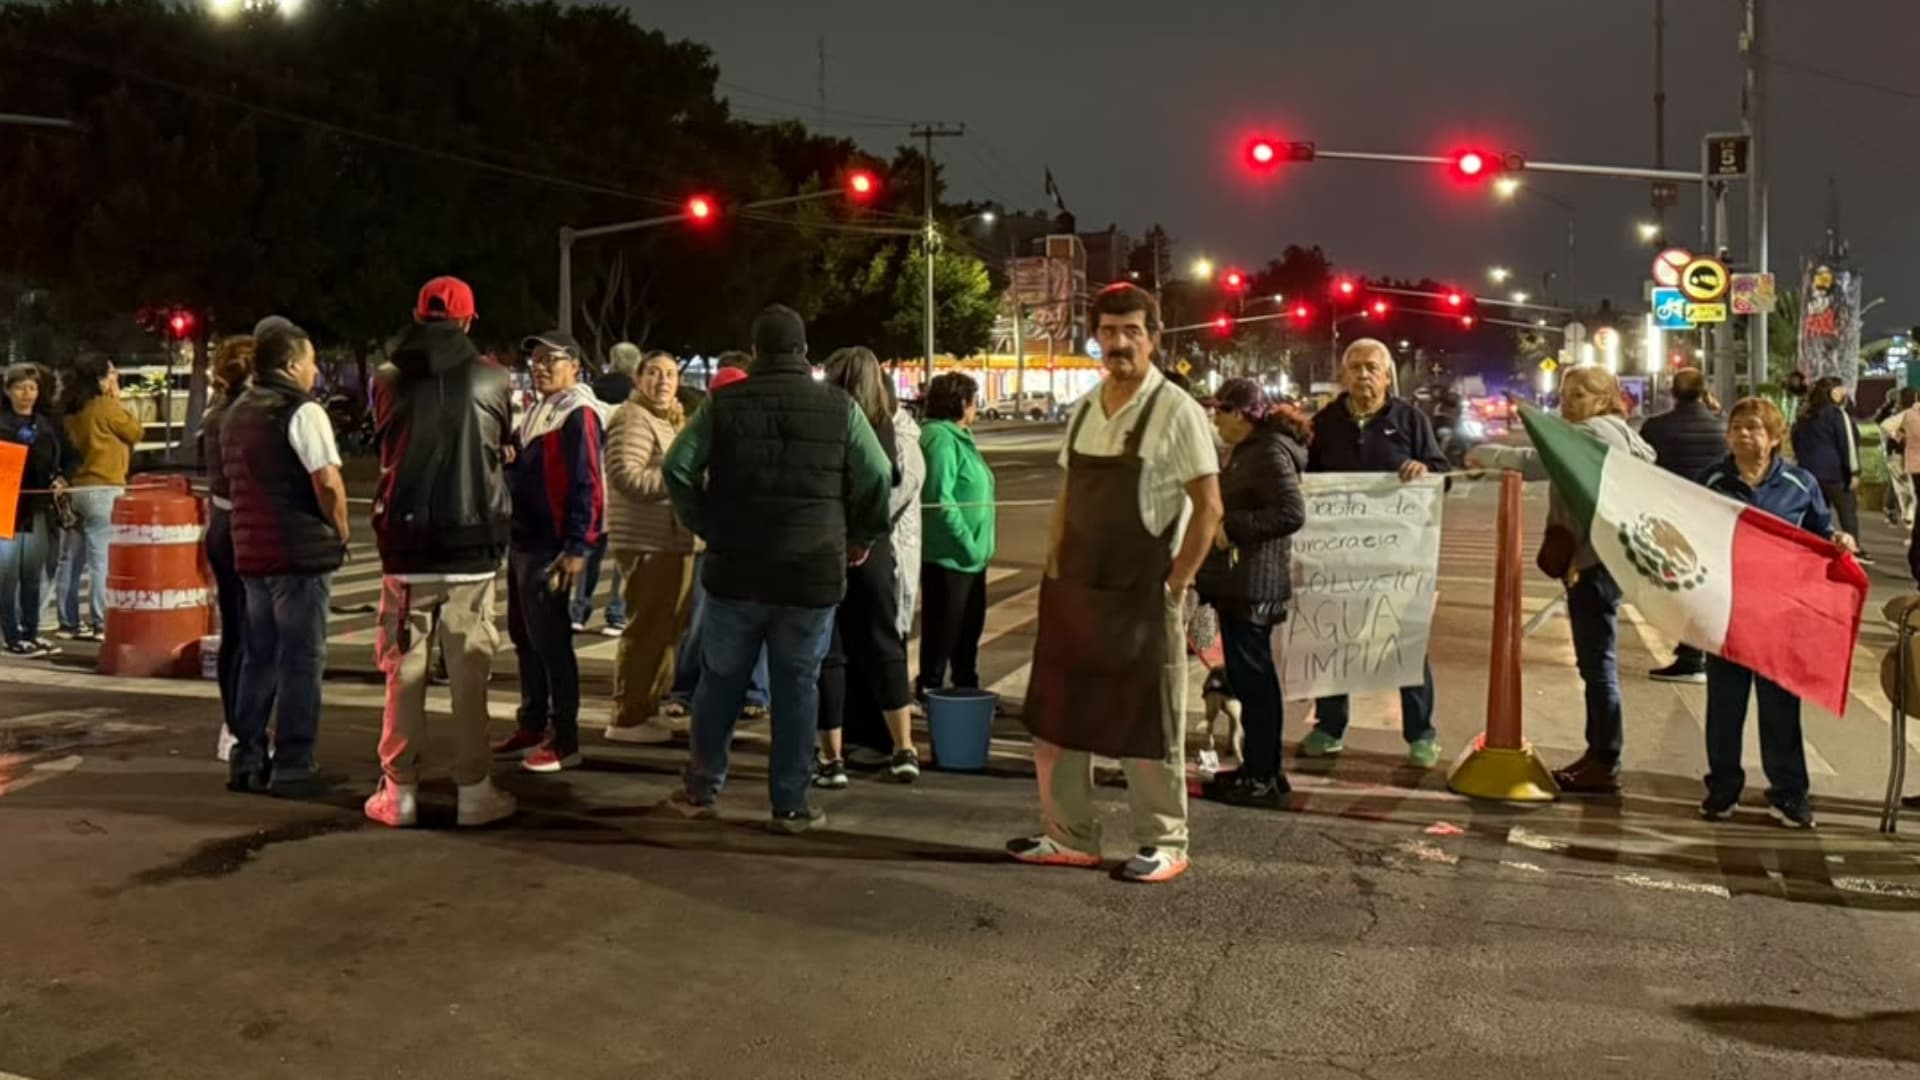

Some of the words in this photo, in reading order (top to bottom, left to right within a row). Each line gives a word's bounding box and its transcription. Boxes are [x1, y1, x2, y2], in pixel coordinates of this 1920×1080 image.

[1386, 494, 1416, 515] de
[1293, 534, 1400, 553] urocracia
[1289, 594, 1400, 644] AGUA
[1282, 634, 1403, 687] LIMPIA
